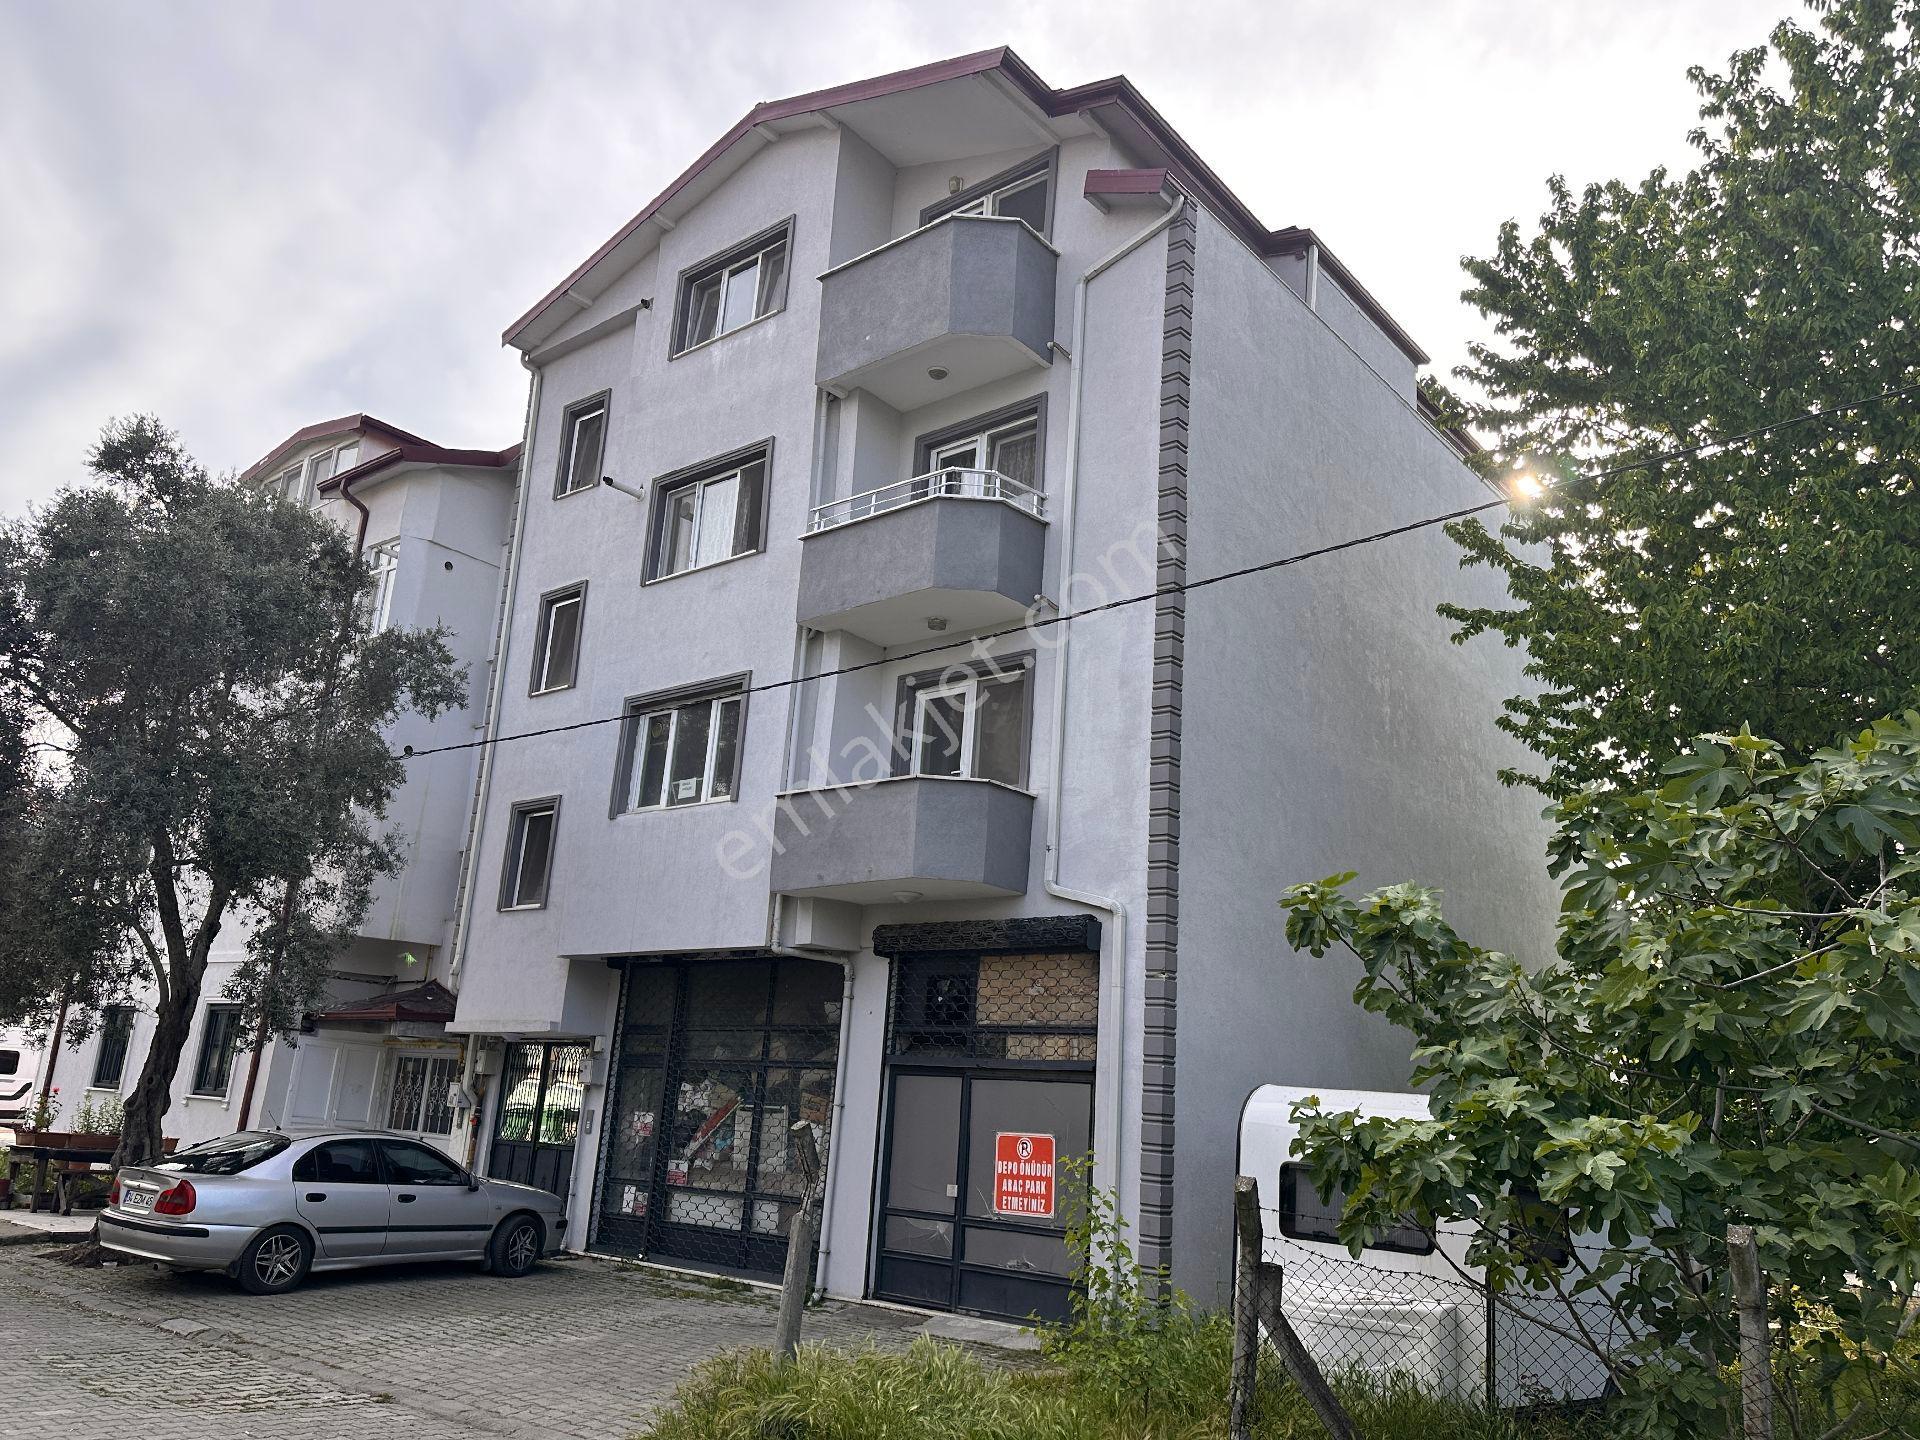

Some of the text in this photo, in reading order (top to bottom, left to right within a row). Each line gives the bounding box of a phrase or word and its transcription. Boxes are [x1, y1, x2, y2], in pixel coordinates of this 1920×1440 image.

[998, 1160, 1052, 1177] DEPO ÖNÜDÜR
[1002, 1179, 1046, 1195] ARAÇ PARK
[1002, 1196, 1046, 1212] ETMEYİNİZ
